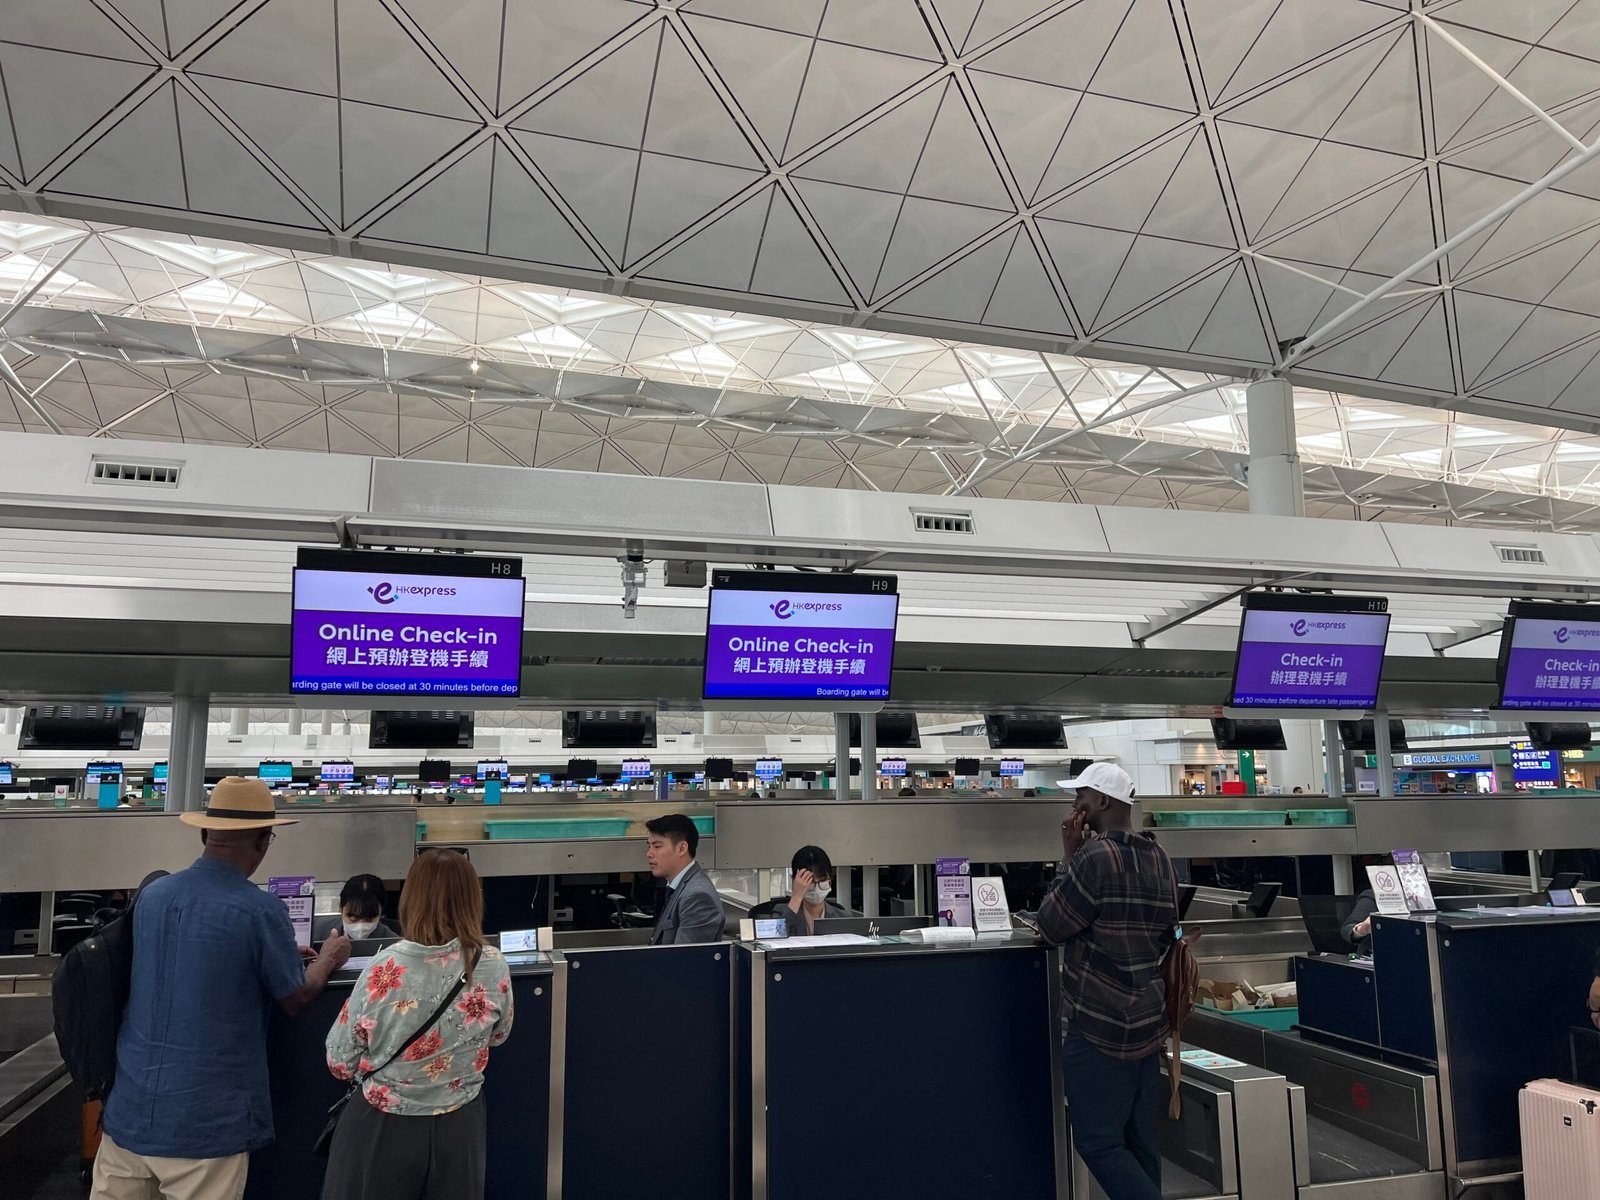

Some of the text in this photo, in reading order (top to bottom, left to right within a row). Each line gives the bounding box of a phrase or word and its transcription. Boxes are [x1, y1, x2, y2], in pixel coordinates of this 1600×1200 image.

[491, 562, 511, 575] H8
[871, 580, 888, 591] H9
[1368, 601, 1387, 611] H10
[318, 623, 498, 645] Online Check-in
[728, 636, 874, 654] Online Check-in
[326, 646, 489, 668] 網上預辦登機手續
[1280, 653, 1343, 667] Check-in
[733, 656, 866, 675] 網上預辦登機手續
[1544, 658, 1600, 672] Check-in
[1270, 670, 1348, 686] 辦理登機手續
[321, 681, 342, 691] gate
[344, 681, 360, 690] will
[361, 681, 373, 690] be
[376, 682, 406, 690] closed
[408, 683, 417, 691] at
[420, 682, 431, 690] 30
[433, 683, 468, 691] minutes
[471, 683, 499, 692] before
[816, 687, 849, 697] Boarding
[851, 688, 867, 697] gate
[868, 688, 881, 696] will
[1245, 696, 1254, 704] 30
[1298, 698, 1326, 706] departure
[1412, 753, 1480, 763] GLOBAL EXCHANGE
